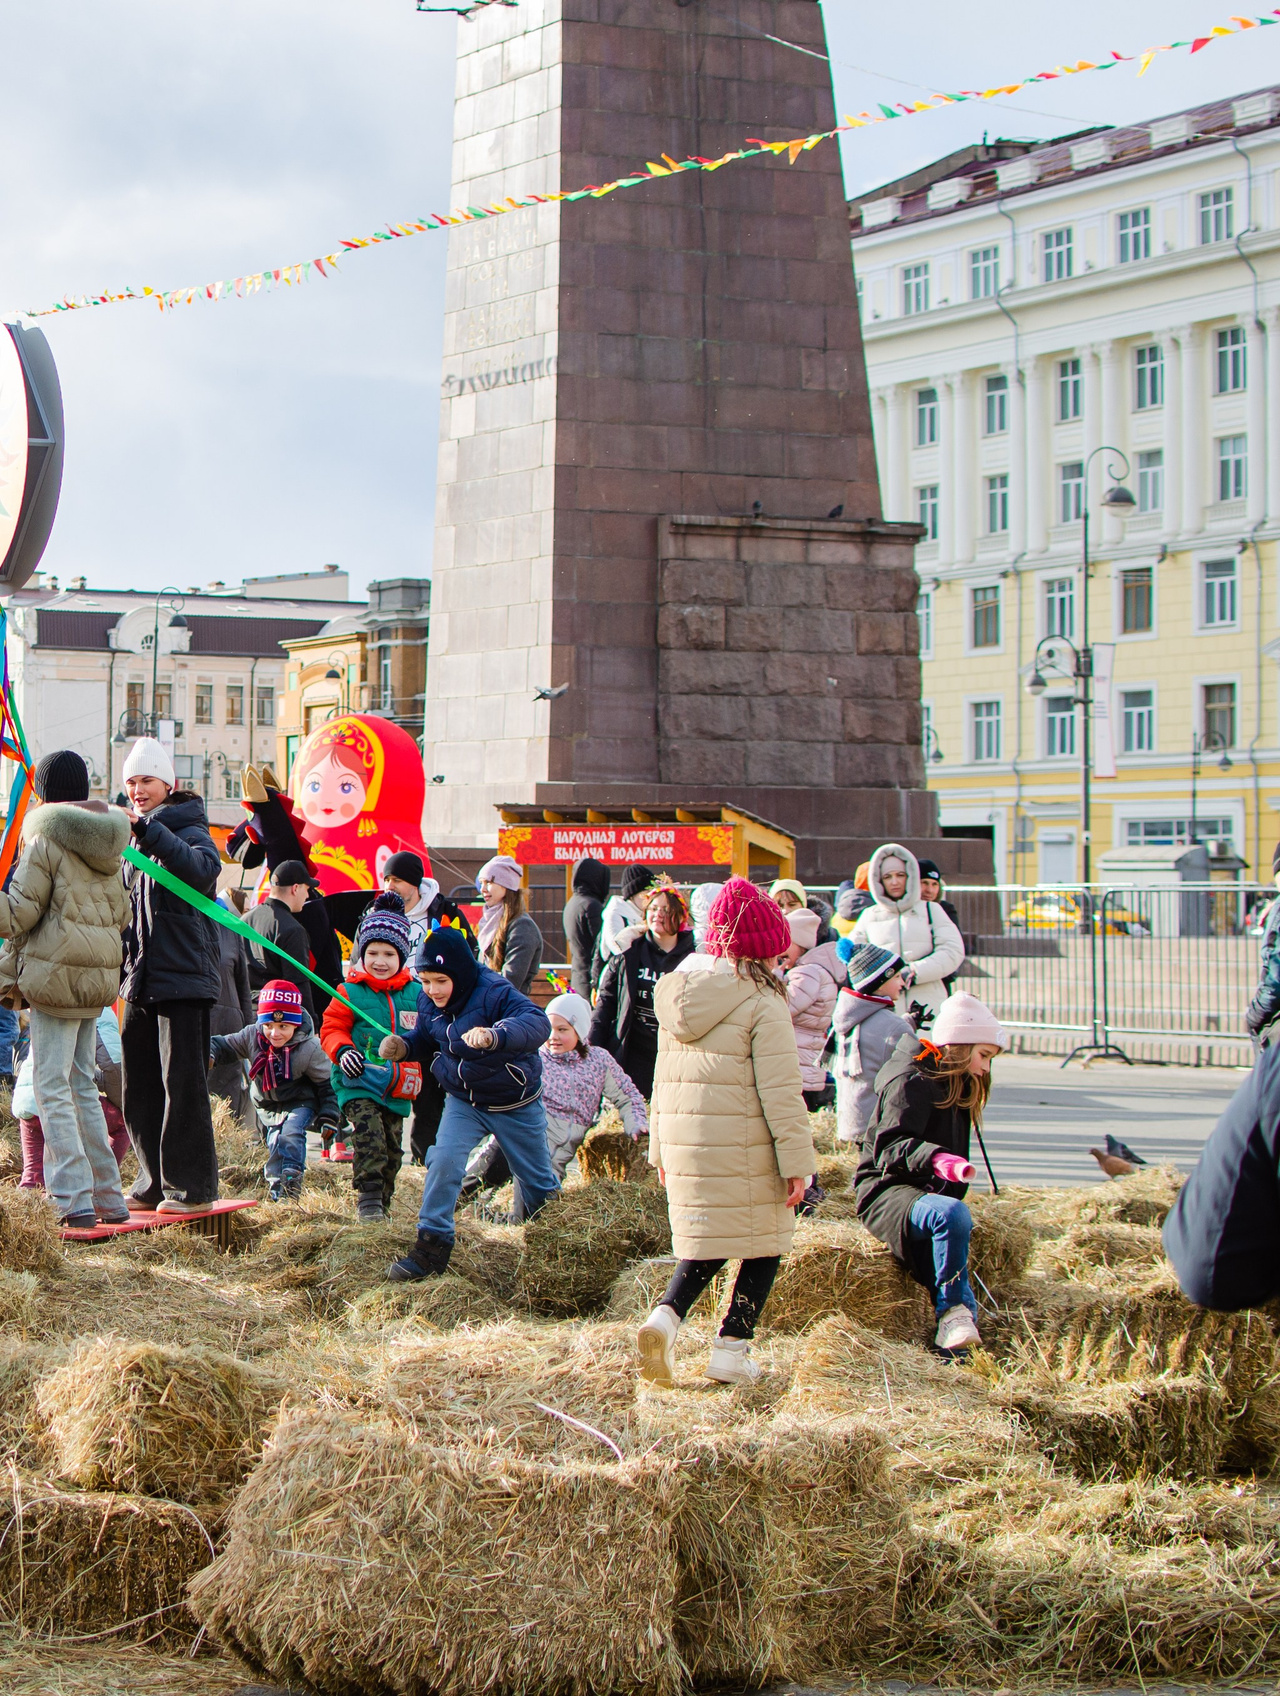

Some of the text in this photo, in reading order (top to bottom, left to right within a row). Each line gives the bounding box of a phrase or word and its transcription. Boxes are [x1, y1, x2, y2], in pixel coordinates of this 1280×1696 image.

[553, 830, 676, 846] НАРОДНАЯ ЛОТЕРЕЯ
[554, 846, 674, 862] ВЫДАЧА ПОДАРКОВ
